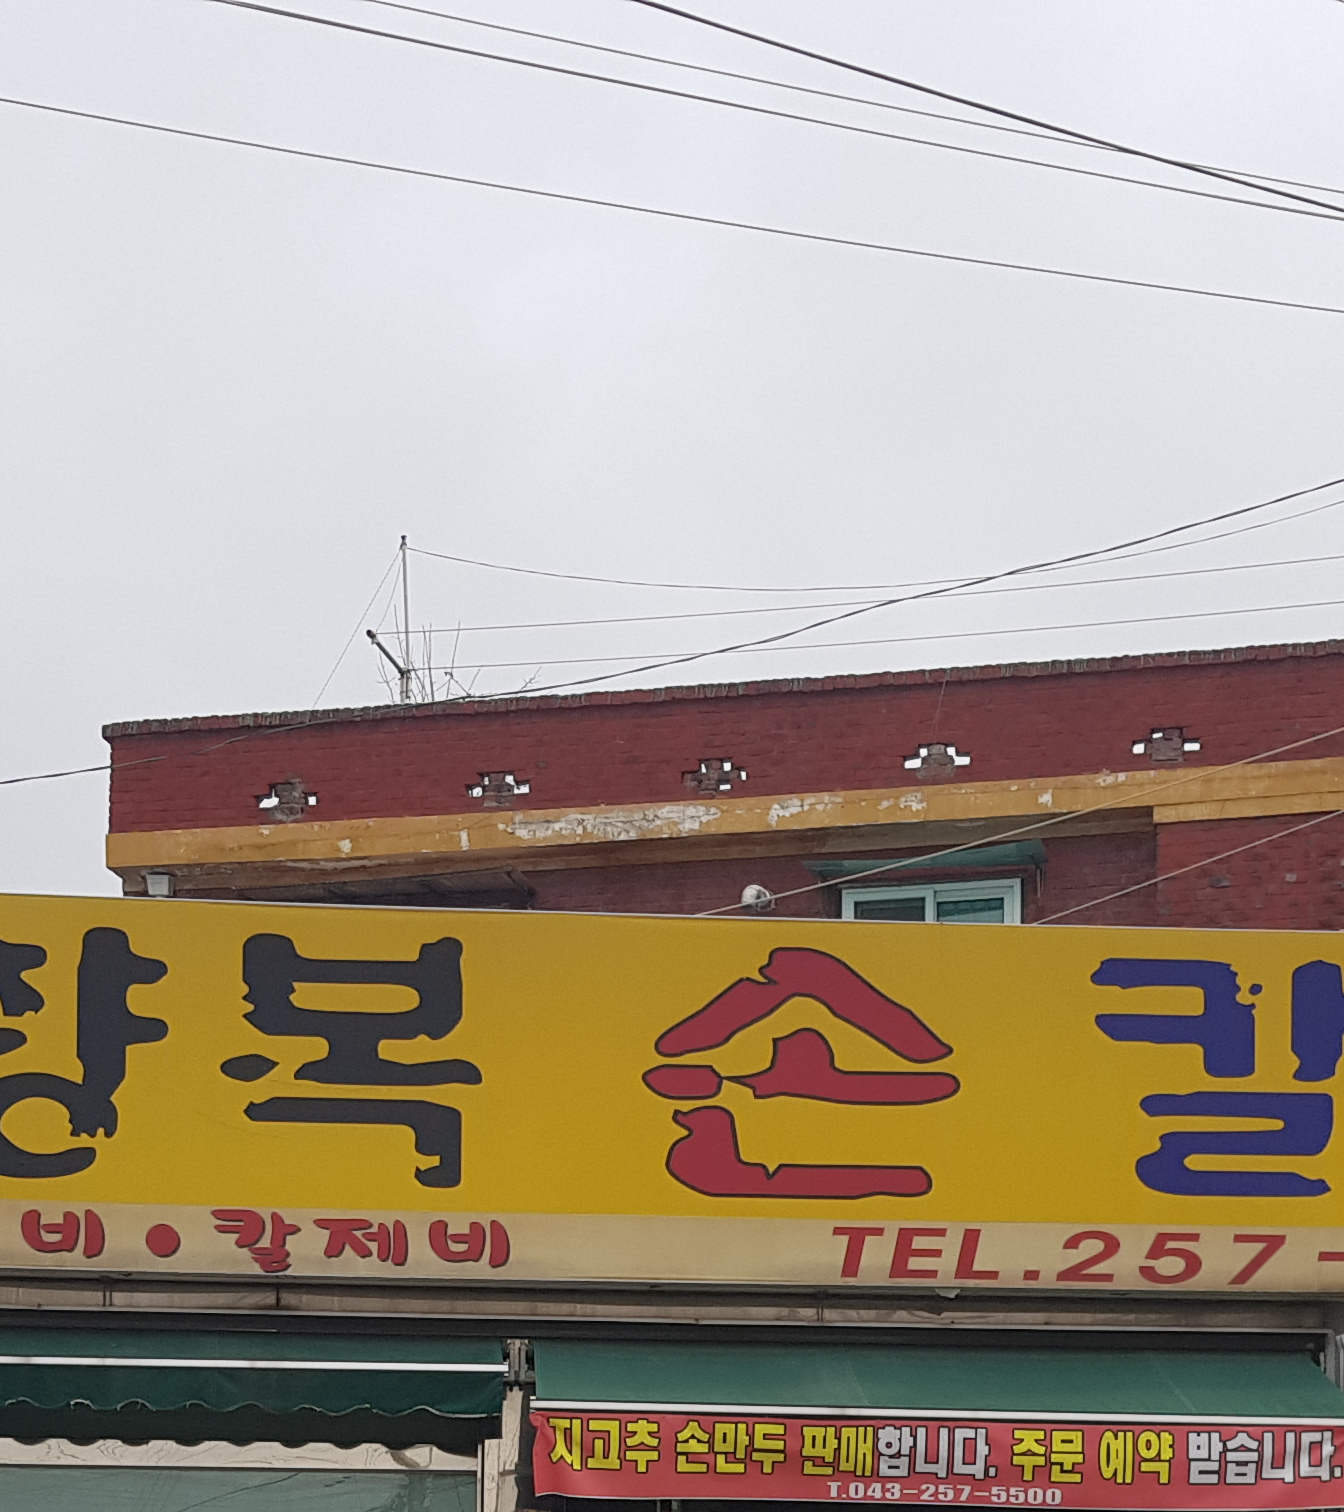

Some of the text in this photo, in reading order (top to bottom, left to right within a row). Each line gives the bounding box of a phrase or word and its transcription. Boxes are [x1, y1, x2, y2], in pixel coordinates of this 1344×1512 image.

[642, 946, 960, 1198] 손
[210, 1206, 509, 1270] 칼제비
[549, 1417, 1344, 1485] 지고추 손만두 판매합니다. 주문 예약 받습니다.
[826, 1480, 1063, 1506] T.043-257-5500
